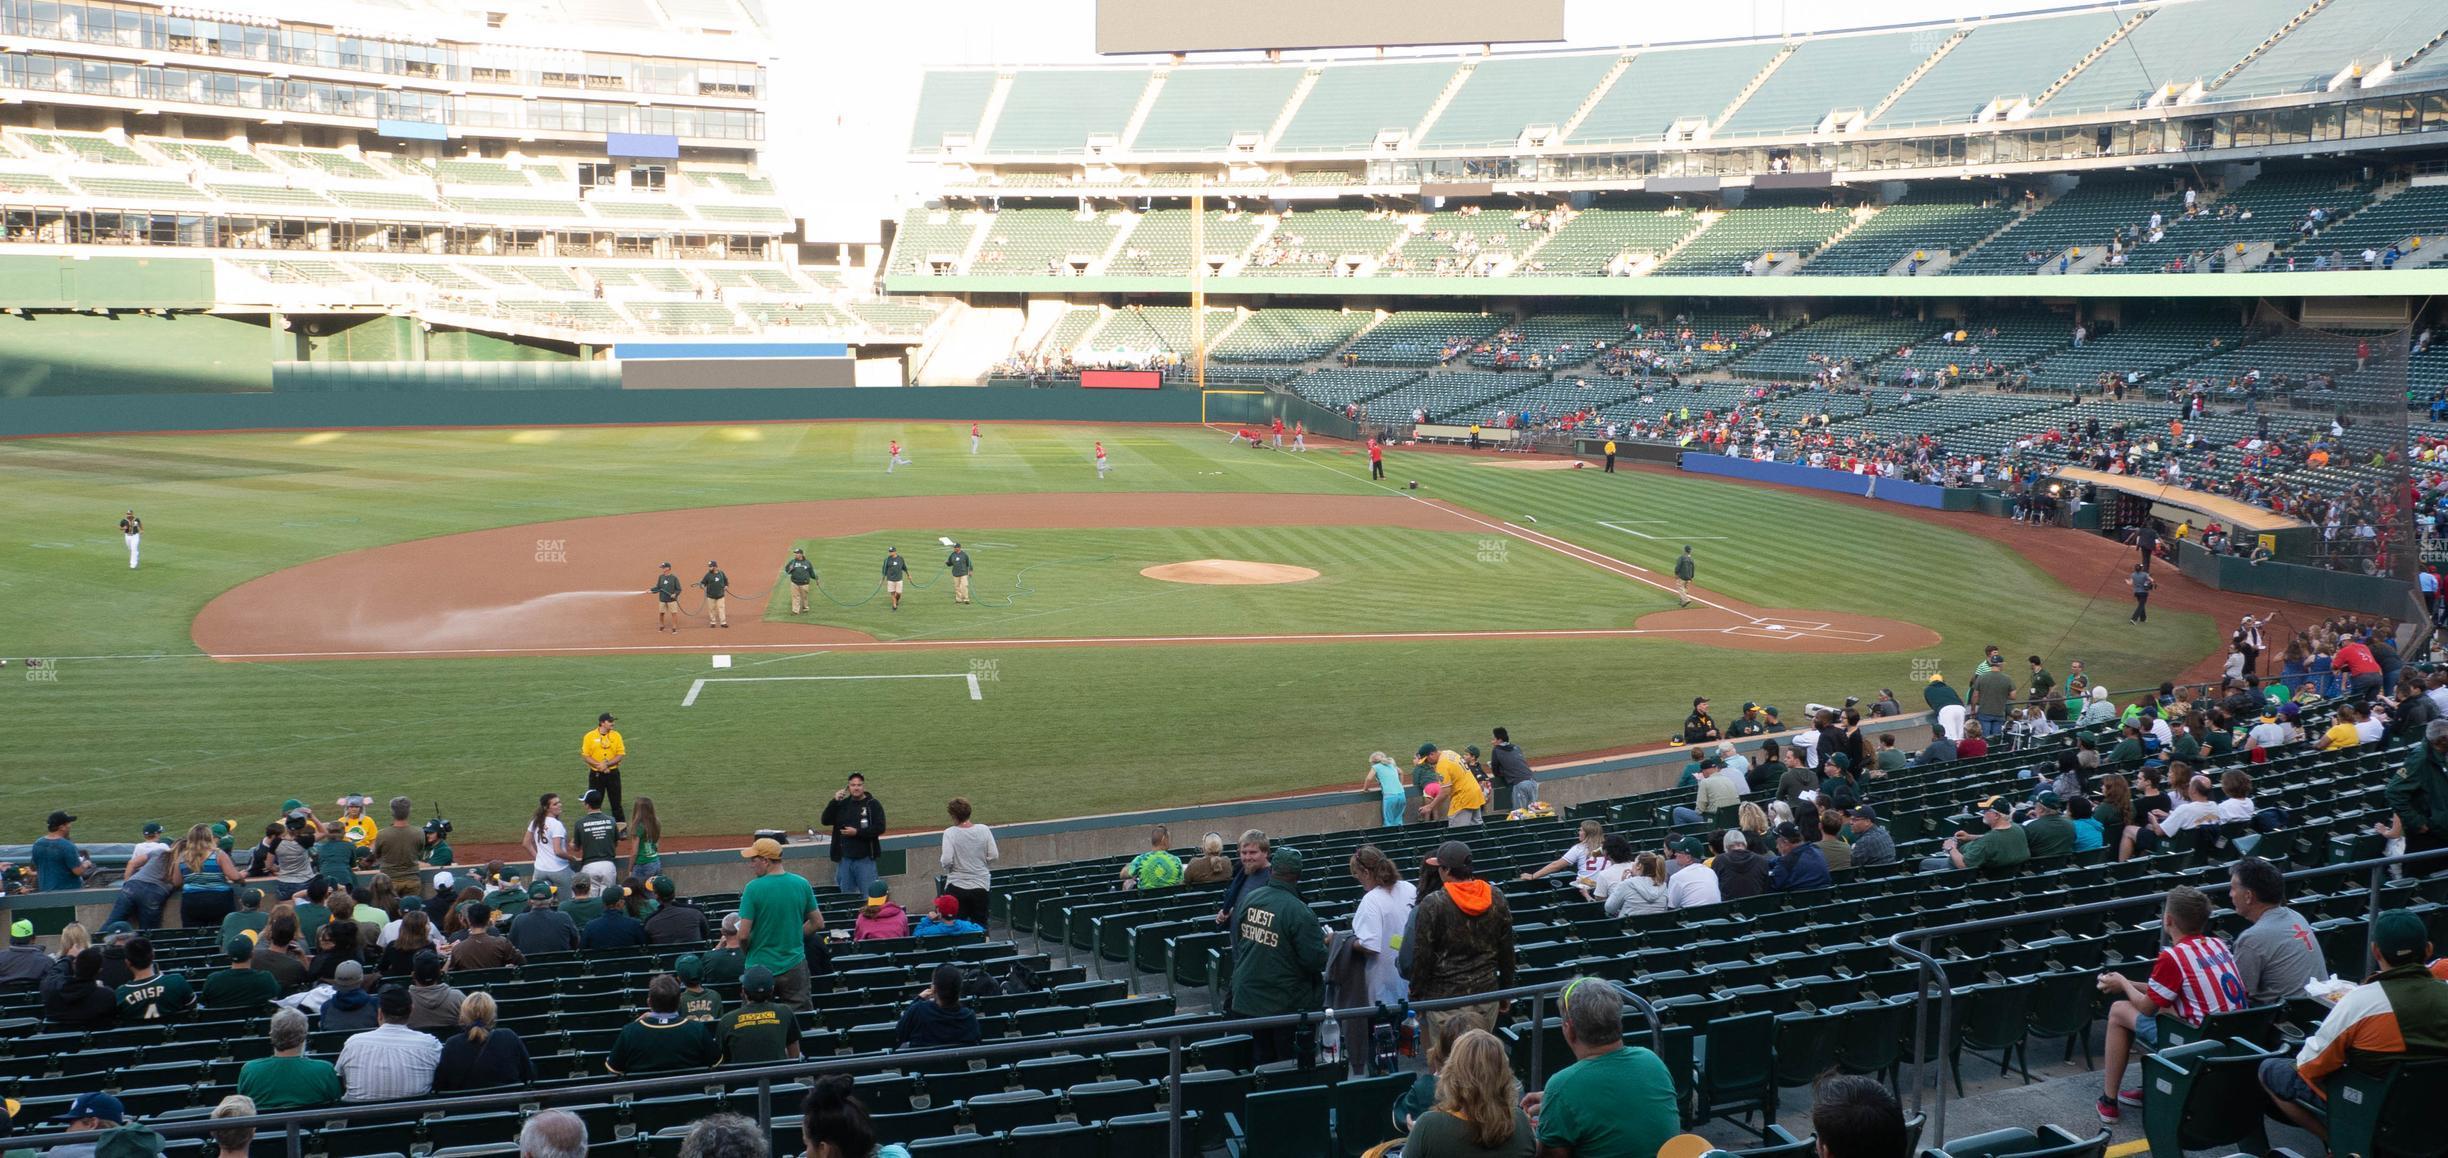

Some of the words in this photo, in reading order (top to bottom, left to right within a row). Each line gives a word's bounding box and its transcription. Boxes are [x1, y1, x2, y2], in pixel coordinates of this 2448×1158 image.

[1248, 908, 1276, 928] GUEST
[126, 986, 165, 1005] CRISP
[2221, 971, 2247, 1010] 9
[686, 1000, 712, 1012] ISAAC
